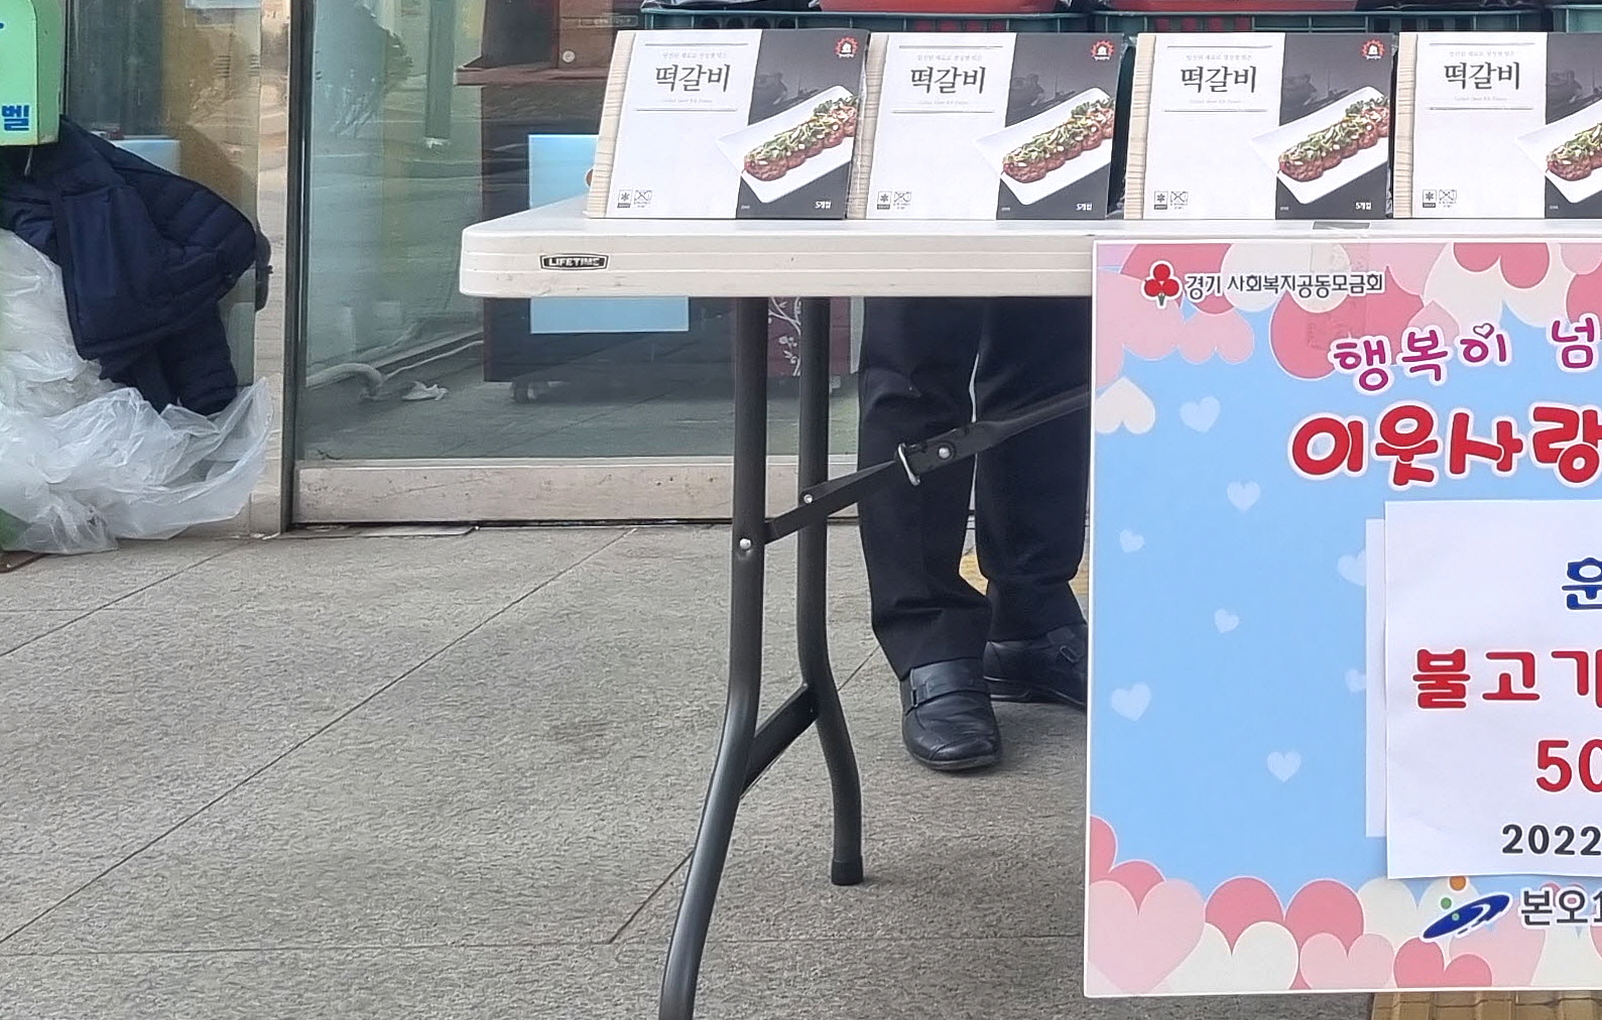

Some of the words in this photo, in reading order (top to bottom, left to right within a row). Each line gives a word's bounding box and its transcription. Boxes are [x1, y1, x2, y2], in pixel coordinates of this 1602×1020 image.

[655, 63, 730, 93] 떡갈비
[910, 65, 986, 95] 떡갈비
[1180, 65, 1257, 93] 떡갈비
[1444, 60, 1520, 91] 떡갈비
[549, 257, 599, 266] LIFETIME
[1185, 273, 1222, 301] 경기
[1227, 272, 1384, 300] 사회복지공동모금회
[1333, 323, 1508, 391] 행복이
